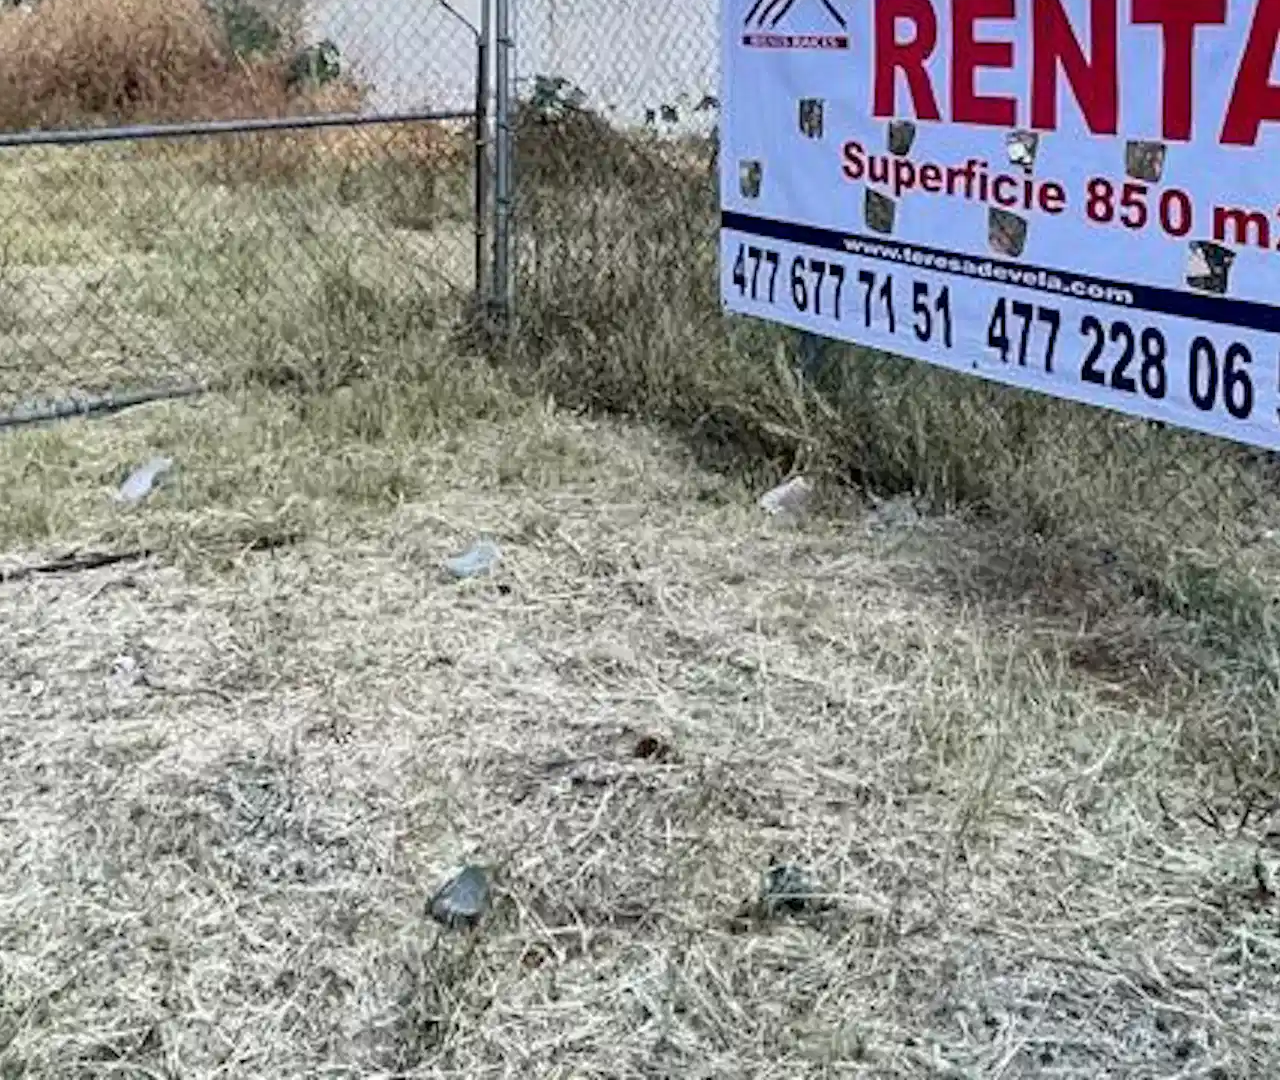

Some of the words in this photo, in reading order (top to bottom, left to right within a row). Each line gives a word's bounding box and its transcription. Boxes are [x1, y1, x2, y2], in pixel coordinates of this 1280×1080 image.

[842, 140, 1066, 214] Superficie
[1086, 176, 1193, 237] 850
[843, 237, 1134, 305] www.teresadevela.com
[732, 242, 780, 304] 477
[790, 255, 845, 321] 677
[858, 269, 896, 333] 71
[912, 280, 952, 349] 51
[987, 297, 1061, 374] 477
[1080, 315, 1167, 400] 228
[1188, 335, 1254, 420] 06
